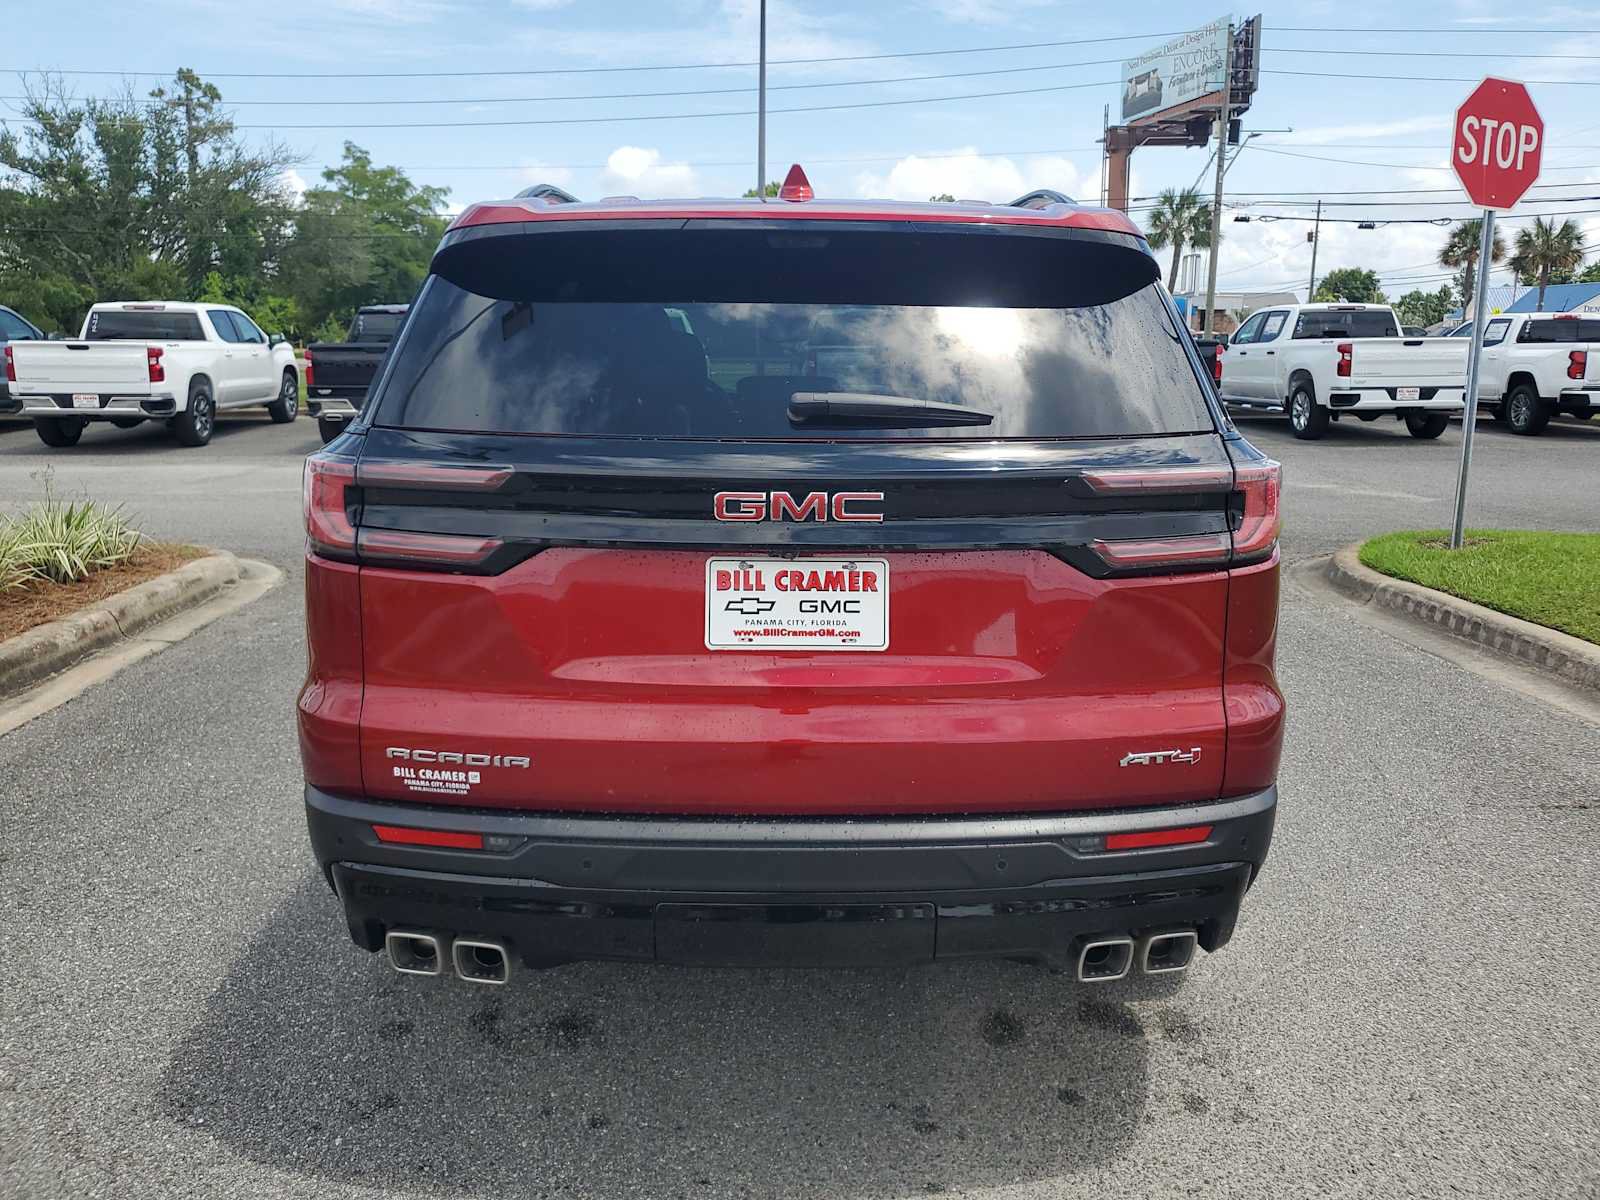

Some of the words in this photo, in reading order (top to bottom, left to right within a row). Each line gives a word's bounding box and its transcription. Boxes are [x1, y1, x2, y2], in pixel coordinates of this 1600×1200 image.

[1458, 115, 1539, 171] STOP
[713, 491, 884, 522] GMC
[716, 570, 766, 592] BILL
[774, 570, 878, 592] CRAMER
[799, 600, 861, 613] GMC
[745, 619, 783, 627] PANAMA
[787, 619, 807, 627] CITY,
[811, 619, 847, 627] FLORIDA
[733, 628, 861, 637] www.BillCramerGM.com
[386, 747, 530, 769] ACADIA
[1119, 747, 1201, 767] AT4
[393, 766, 416, 778] BILL
[419, 768, 466, 782] CRAMER
[404, 779, 430, 787] PANAMA
[446, 782, 471, 790] FLORIDA
